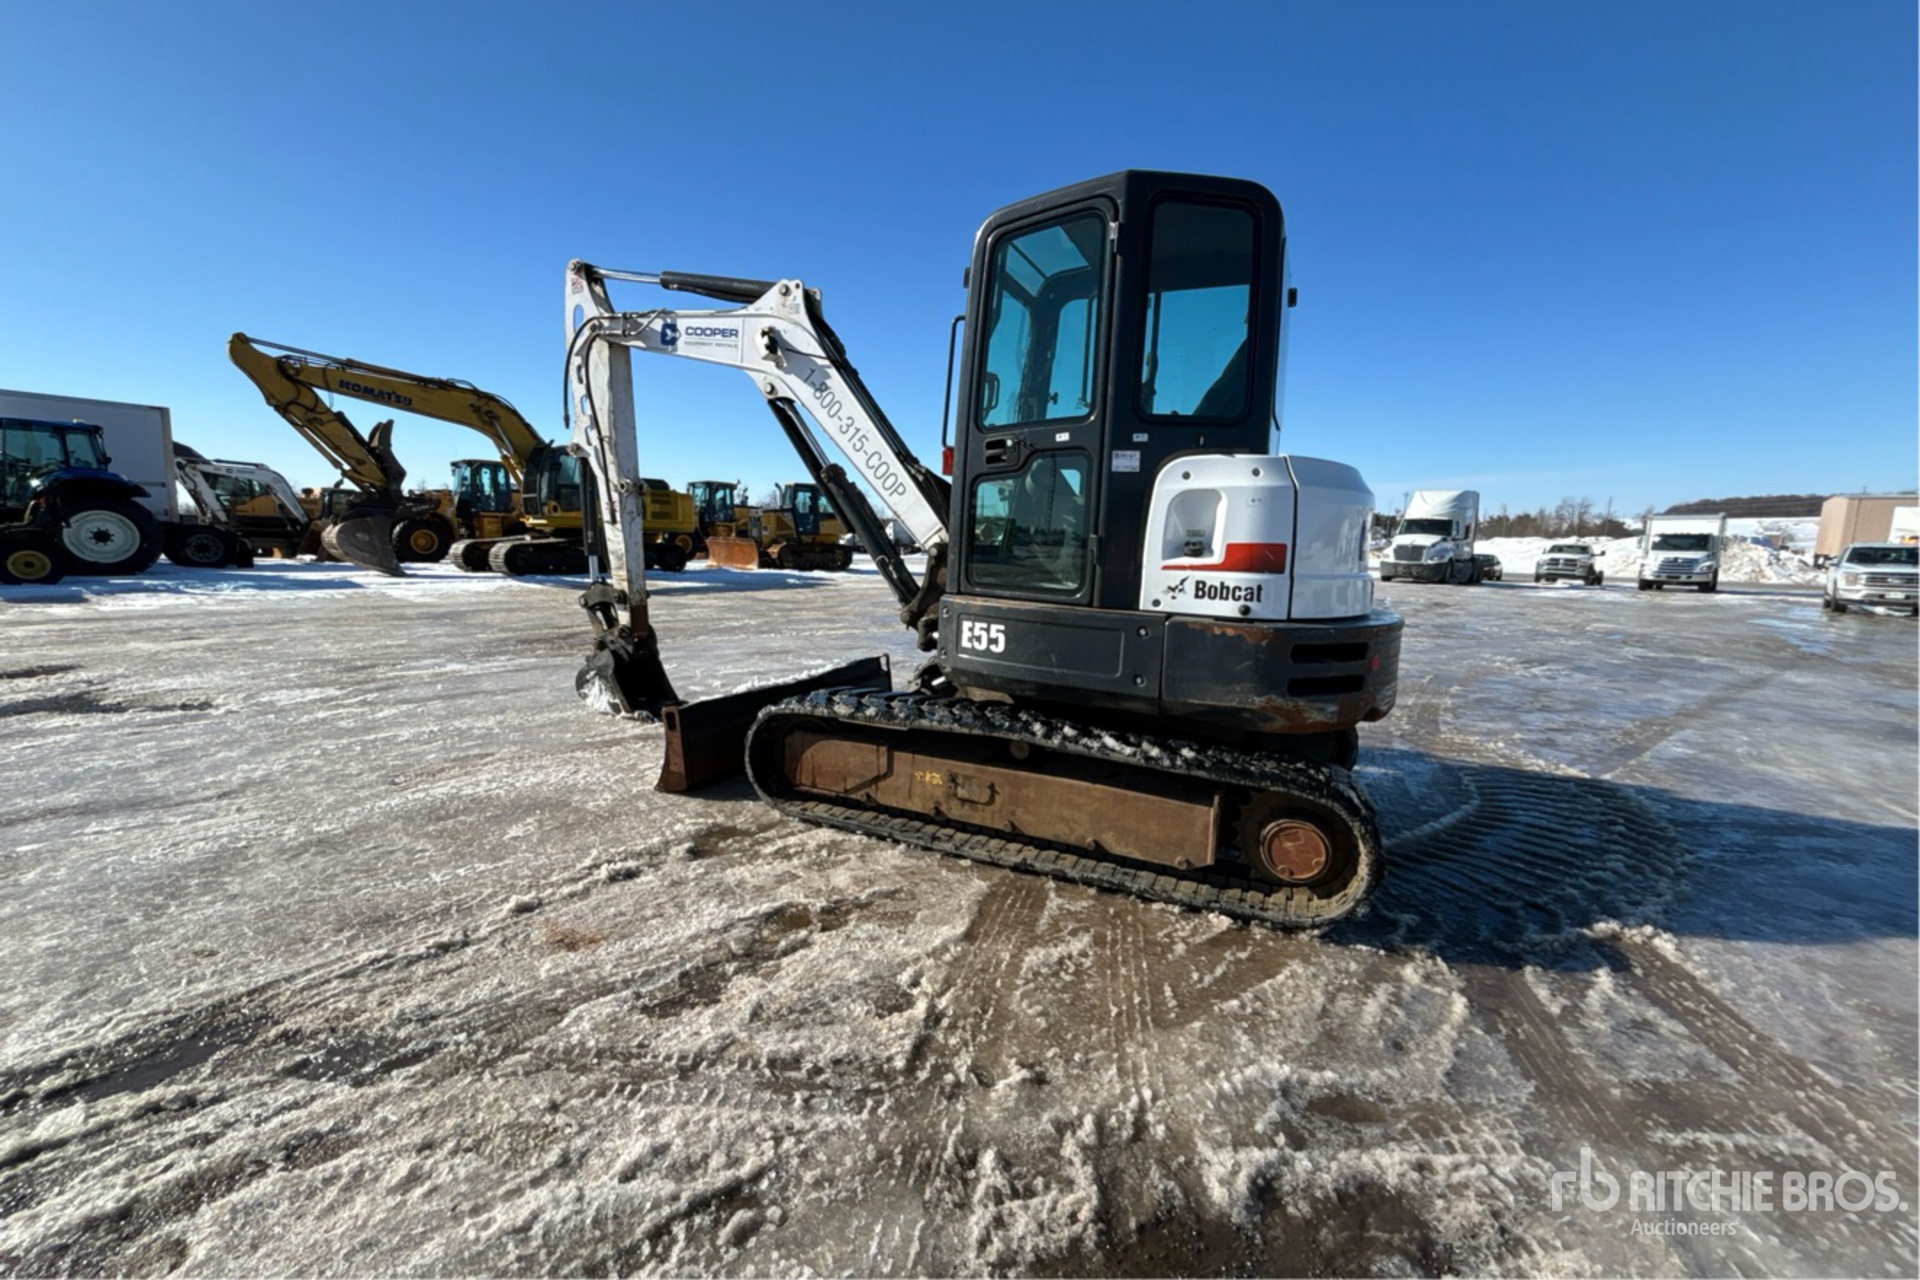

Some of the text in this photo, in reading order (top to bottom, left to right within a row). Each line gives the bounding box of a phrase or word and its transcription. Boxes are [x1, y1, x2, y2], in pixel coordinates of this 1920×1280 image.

[685, 326, 739, 338] COOPER
[338, 379, 412, 406] KOMATSU
[803, 368, 907, 497] 1-800-315-COOP
[1194, 580, 1262, 603] Bobcat
[961, 620, 1006, 653] E55
